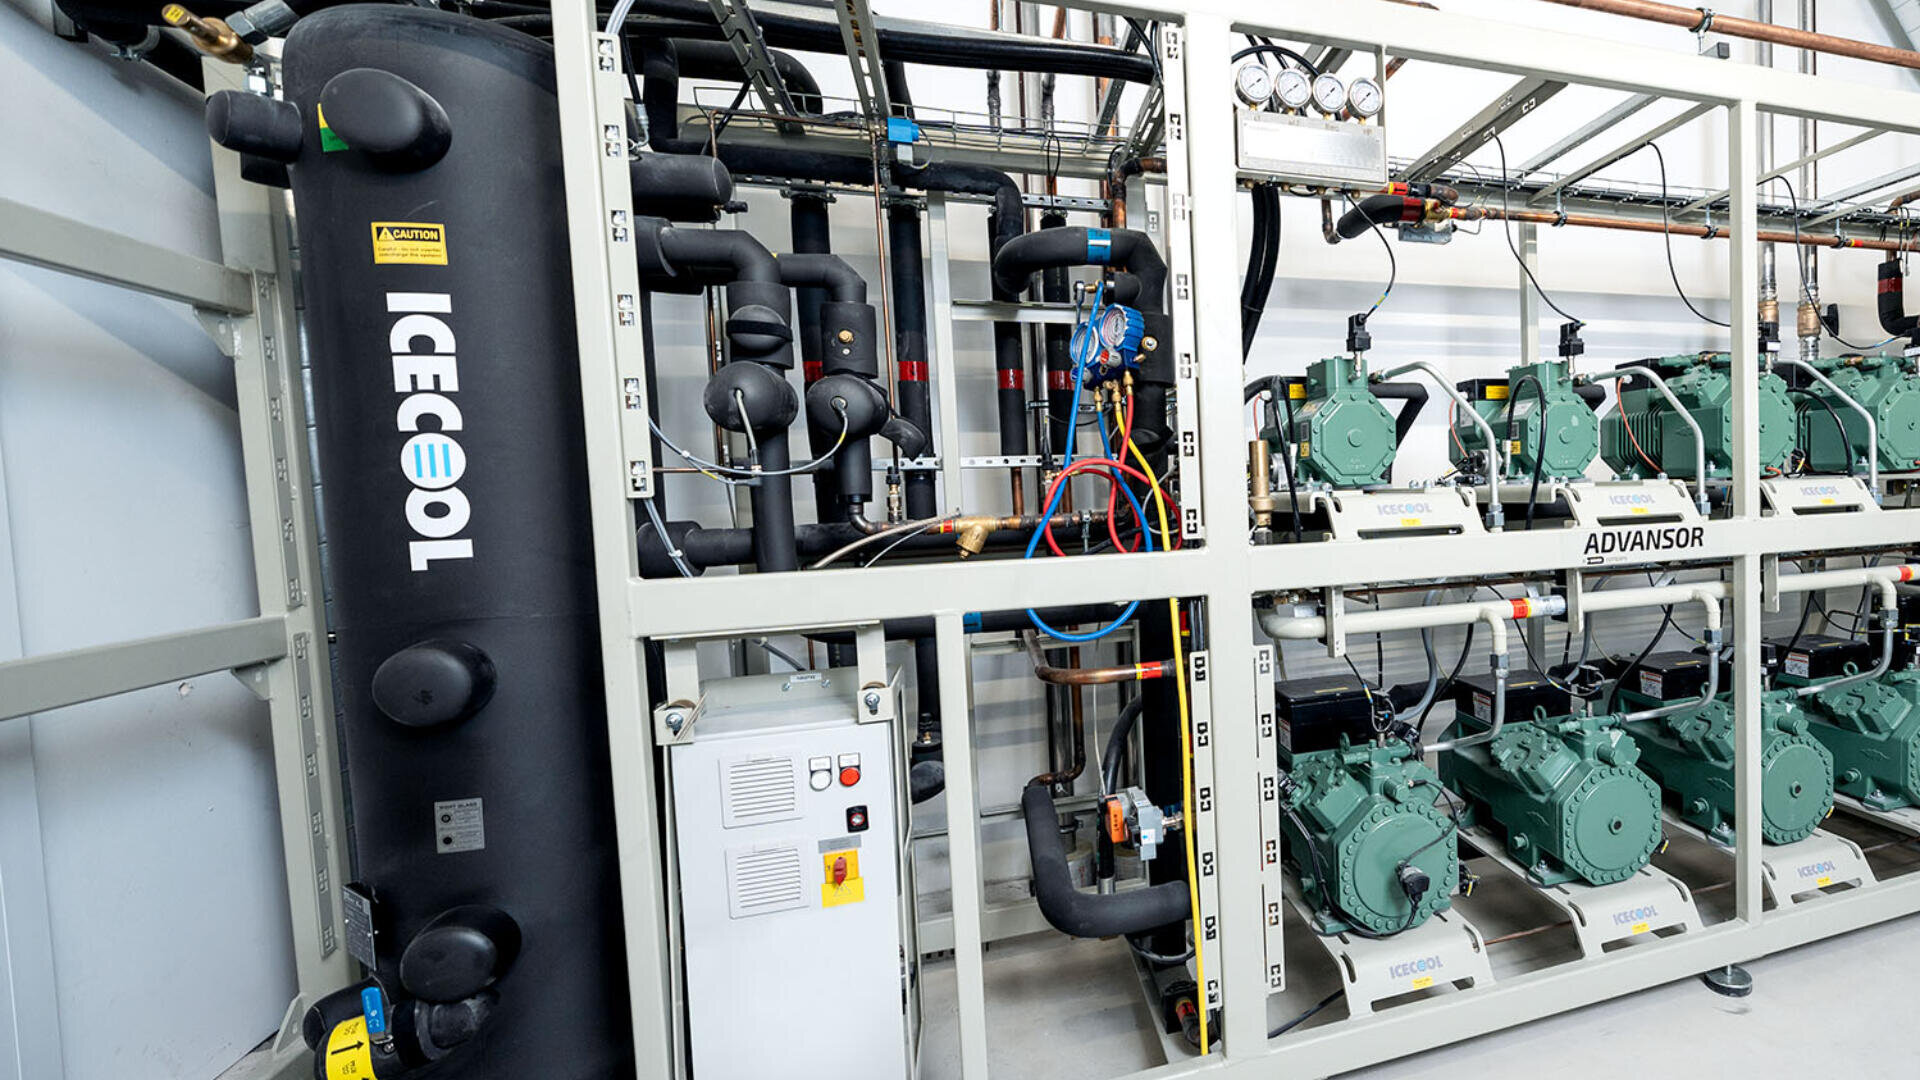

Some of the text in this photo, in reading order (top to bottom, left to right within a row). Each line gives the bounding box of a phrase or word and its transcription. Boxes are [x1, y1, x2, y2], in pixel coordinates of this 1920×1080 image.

[393, 228, 439, 241] CAUTION
[386, 292, 474, 572] ICECOOL
[1376, 501, 1433, 516] ICECOOL
[1584, 527, 1704, 555] ADVANSOR
[1612, 904, 1659, 926] ICECOOL
[1388, 955, 1444, 979] ICECOOL
